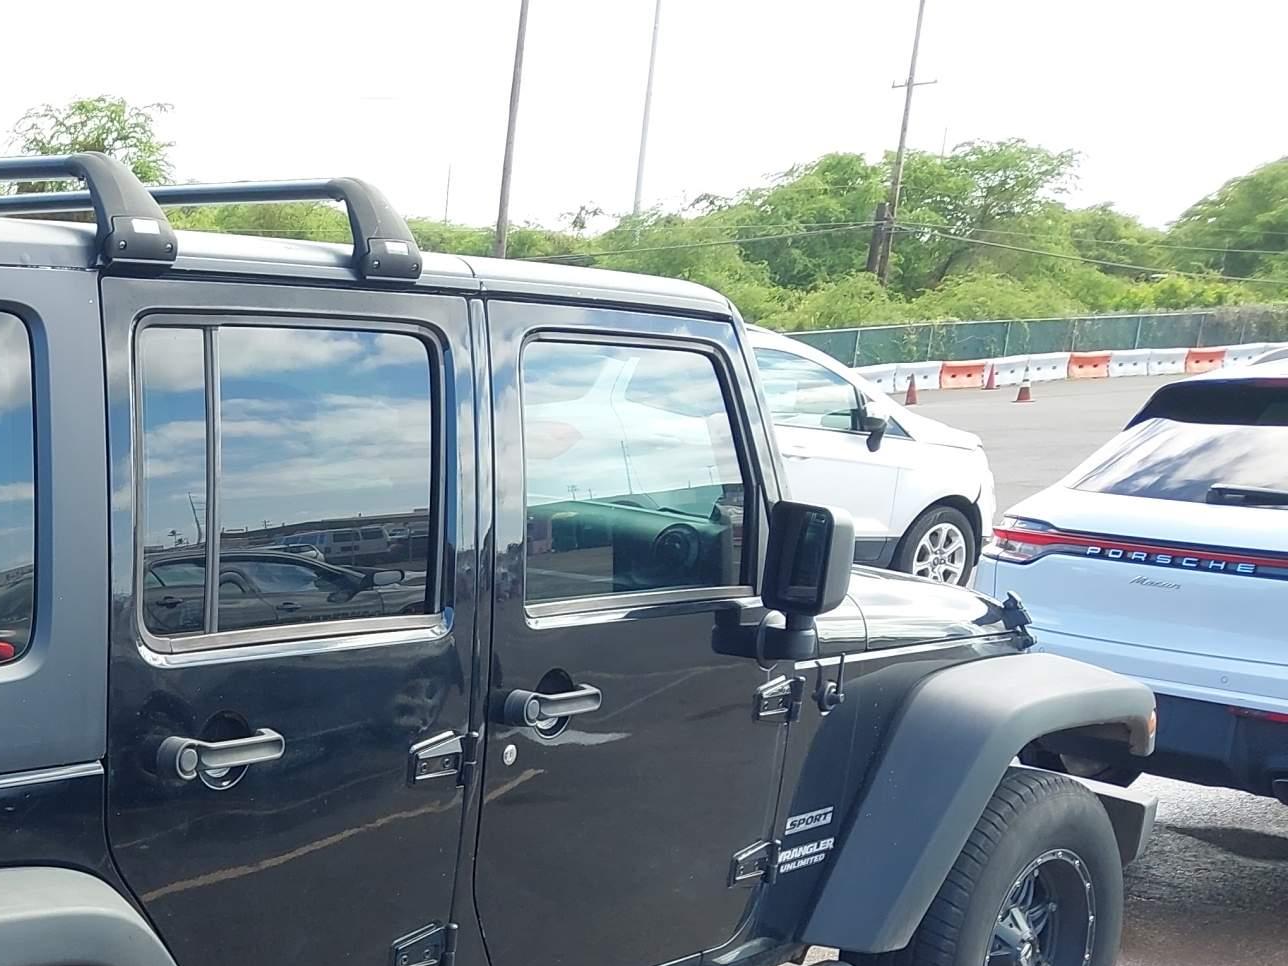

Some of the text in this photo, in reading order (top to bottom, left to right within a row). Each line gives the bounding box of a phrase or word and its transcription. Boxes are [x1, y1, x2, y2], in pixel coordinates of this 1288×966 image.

[1086, 546, 1256, 573] PORSCHE
[788, 811, 831, 831] SPORT
[779, 853, 826, 874] UNLIMITED
